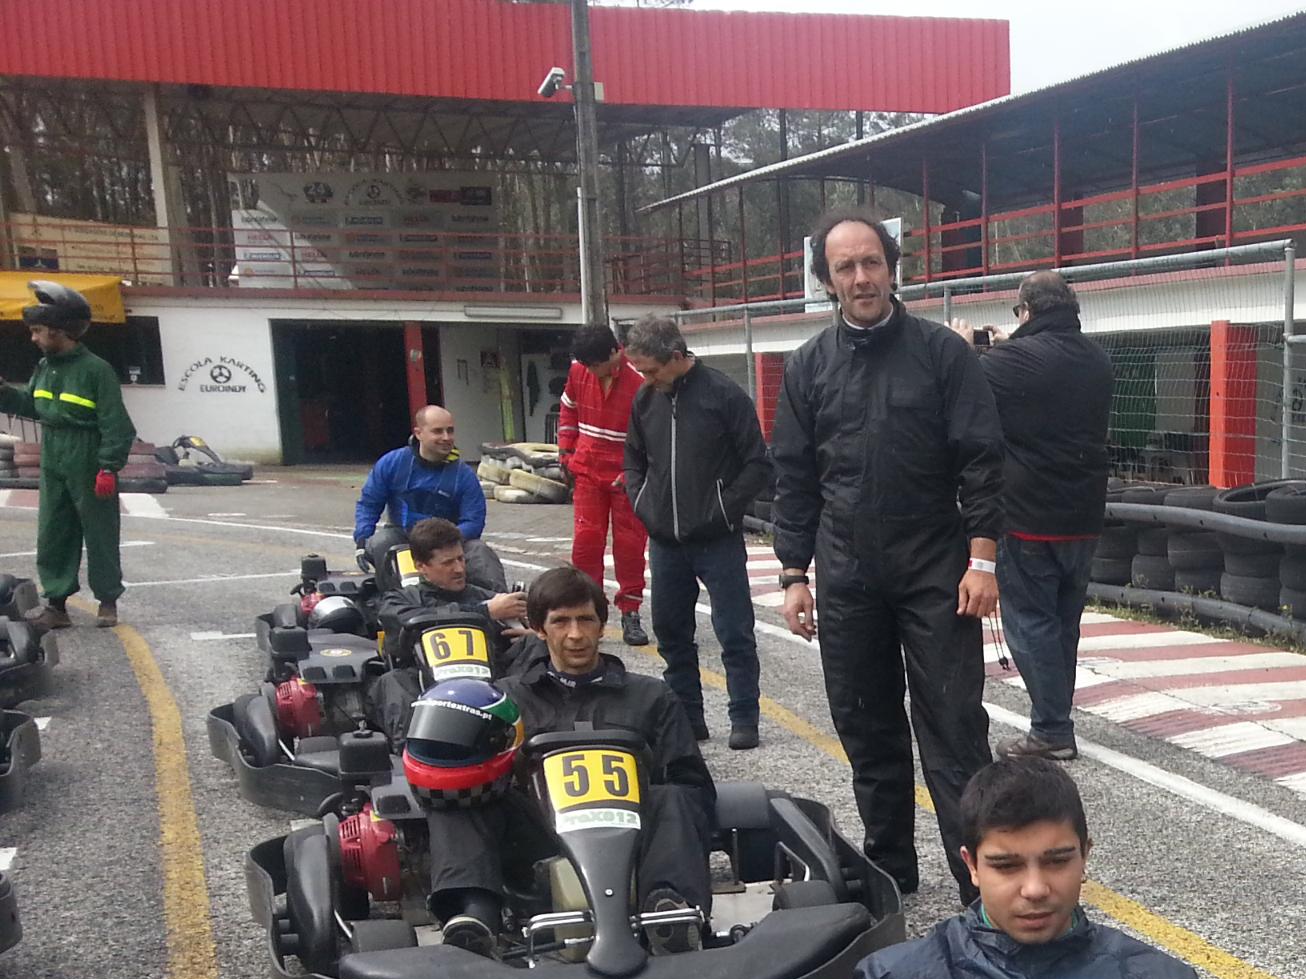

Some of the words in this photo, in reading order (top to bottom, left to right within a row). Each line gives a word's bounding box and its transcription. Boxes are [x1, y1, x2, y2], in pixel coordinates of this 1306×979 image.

[178, 357, 213, 391] ESCOLA
[219, 356, 265, 393] KARTING
[199, 384, 246, 393] EUROINDY
[429, 630, 475, 661] 67
[561, 754, 630, 797] 55
